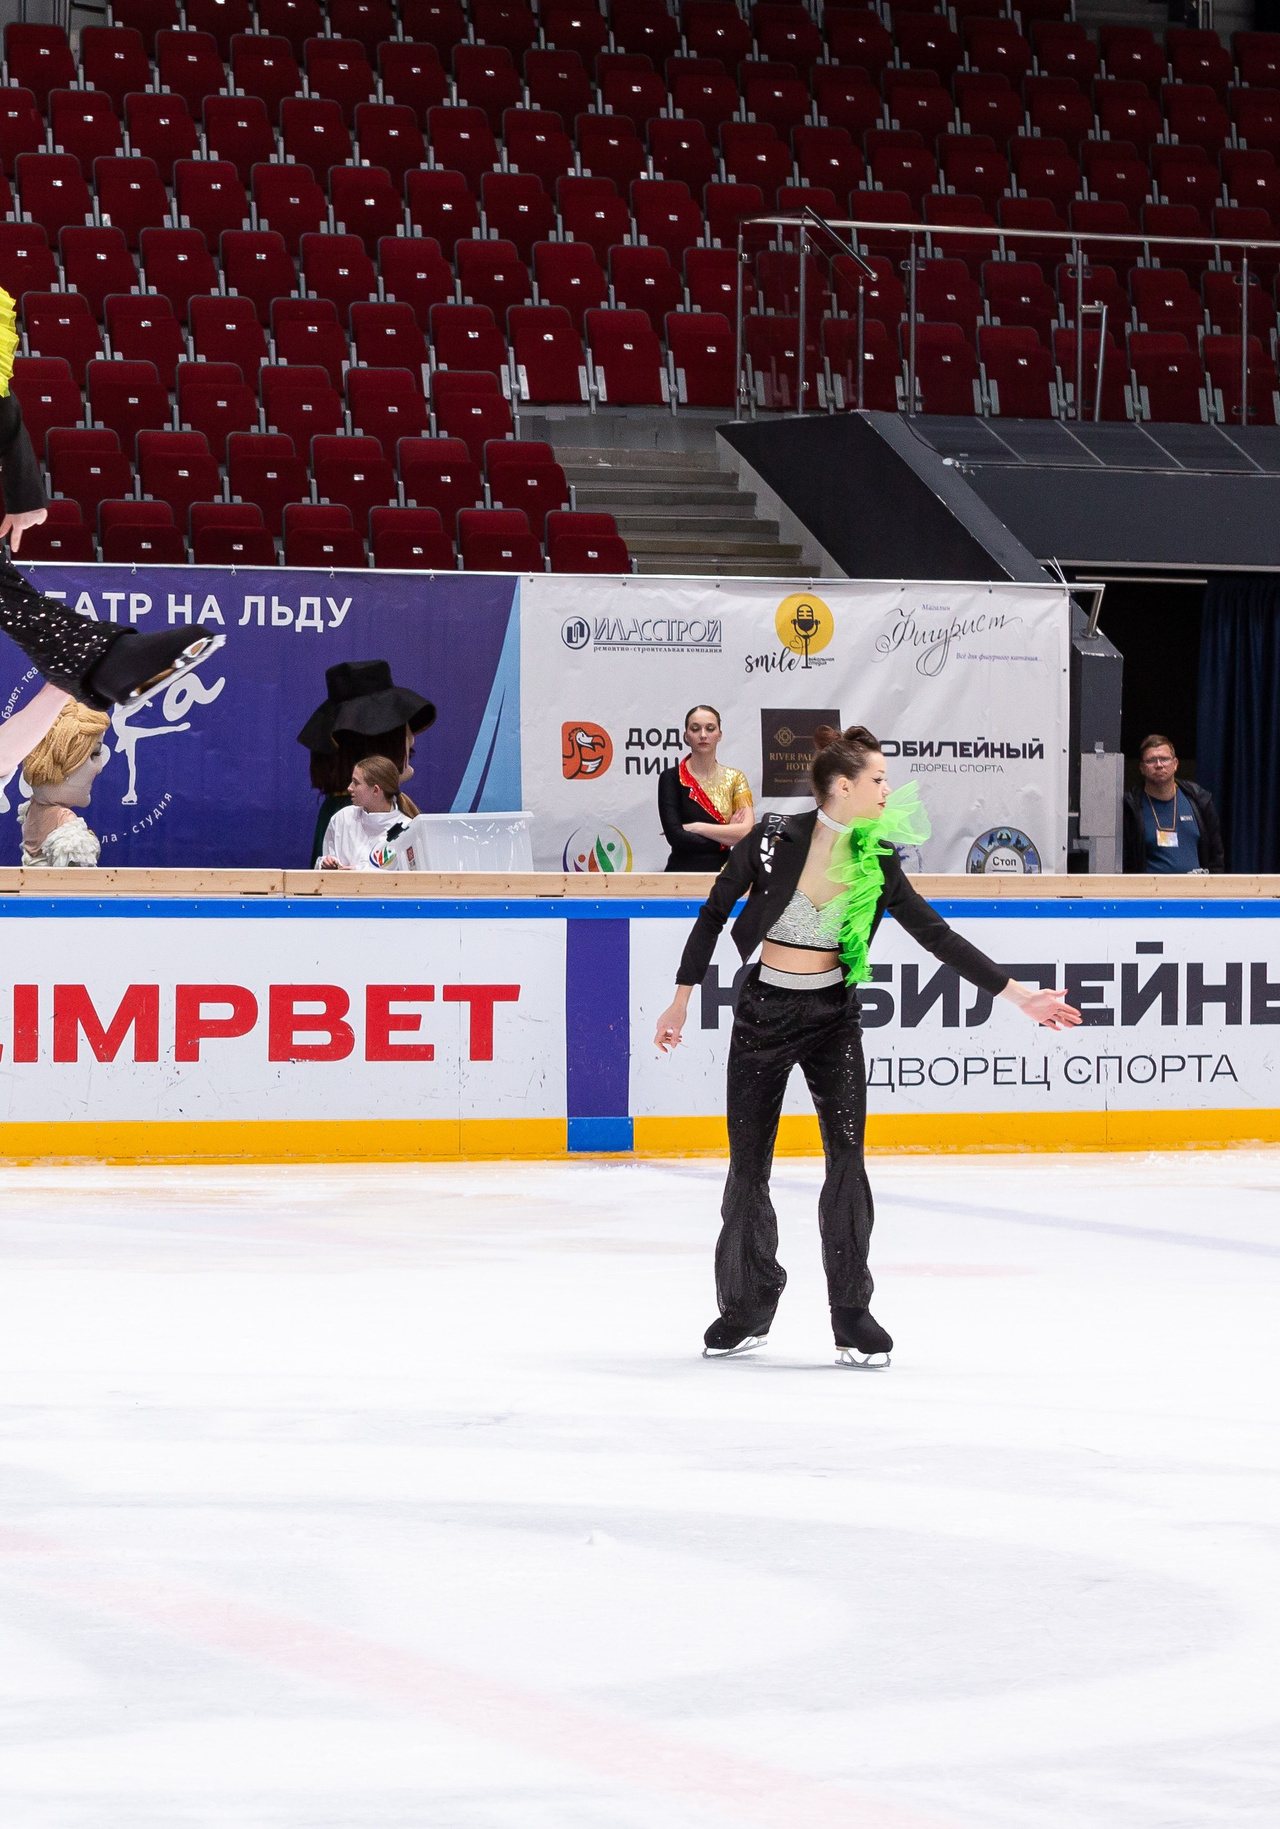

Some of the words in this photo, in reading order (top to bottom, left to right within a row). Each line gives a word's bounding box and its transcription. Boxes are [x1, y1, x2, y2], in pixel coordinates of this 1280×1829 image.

[168, 594, 225, 625] НА
[238, 595, 353, 633] ЛЬДУ
[593, 617, 722, 643] ИЛАССТРОЙ
[870, 608, 1023, 677] Фигурист
[593, 645, 685, 654] ремонтно-строительная
[745, 647, 797, 674] smile
[769, 752, 796, 761] RIVER
[910, 763, 957, 774] ДВОРЕЦ
[959, 764, 1005, 774] СПОРТА
[132, 792, 173, 834] студия
[992, 856, 1017, 867] Стоп
[866, 1056, 1050, 1091] ДВОРЕЦ
[1063, 1054, 1239, 1084] СПОРТА
